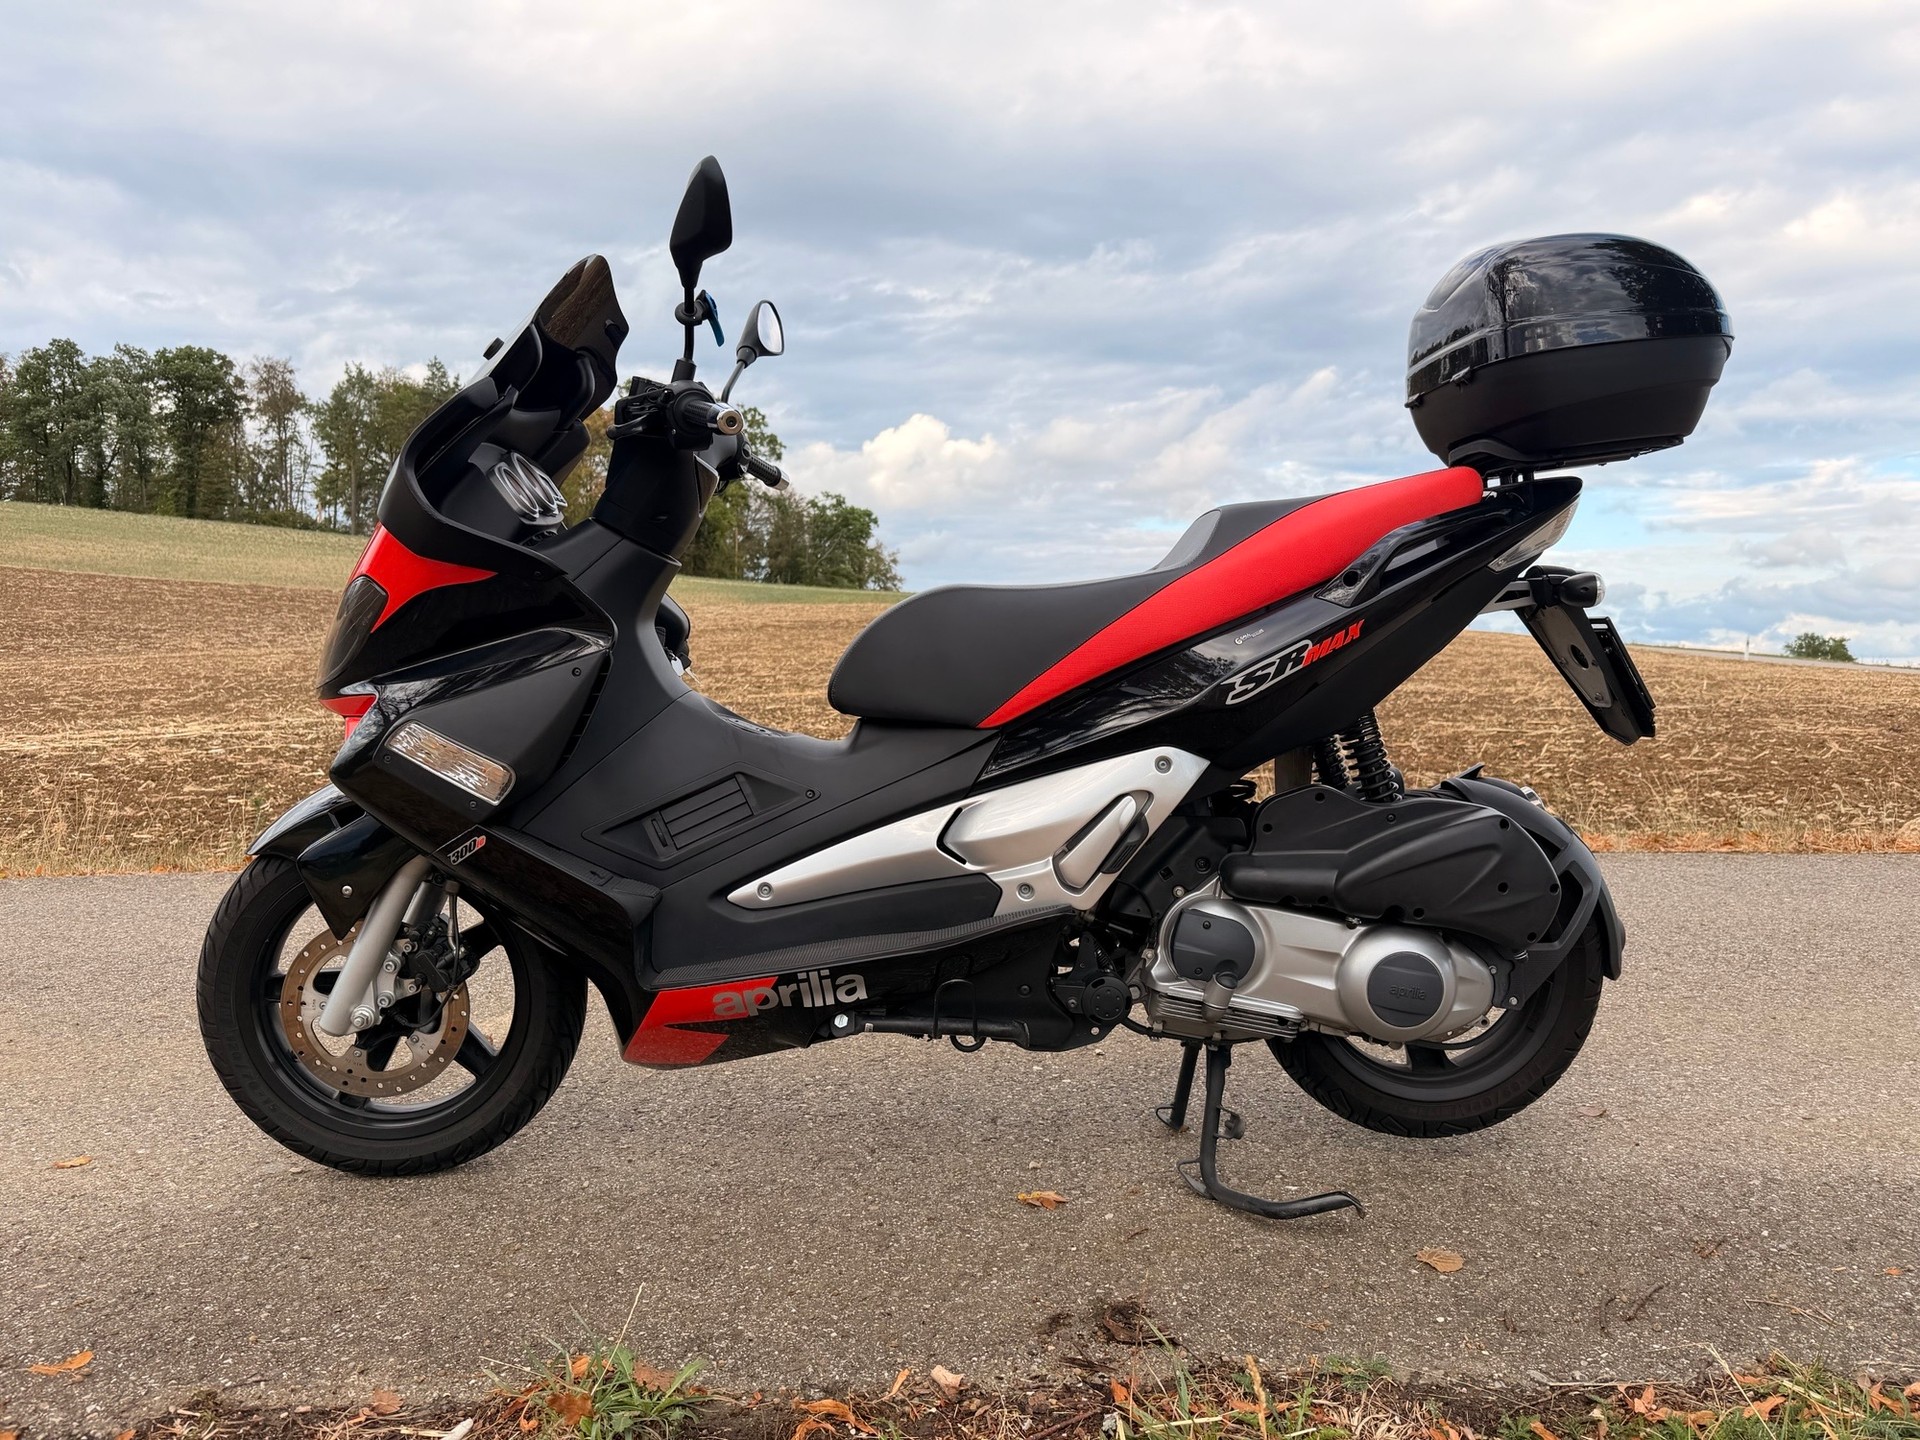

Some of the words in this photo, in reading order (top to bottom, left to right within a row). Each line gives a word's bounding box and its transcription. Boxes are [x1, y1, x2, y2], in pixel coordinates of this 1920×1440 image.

[1302, 618, 1366, 668] MAX
[712, 969, 869, 1017] aprilia
[1389, 984, 1426, 1000] aprilia
